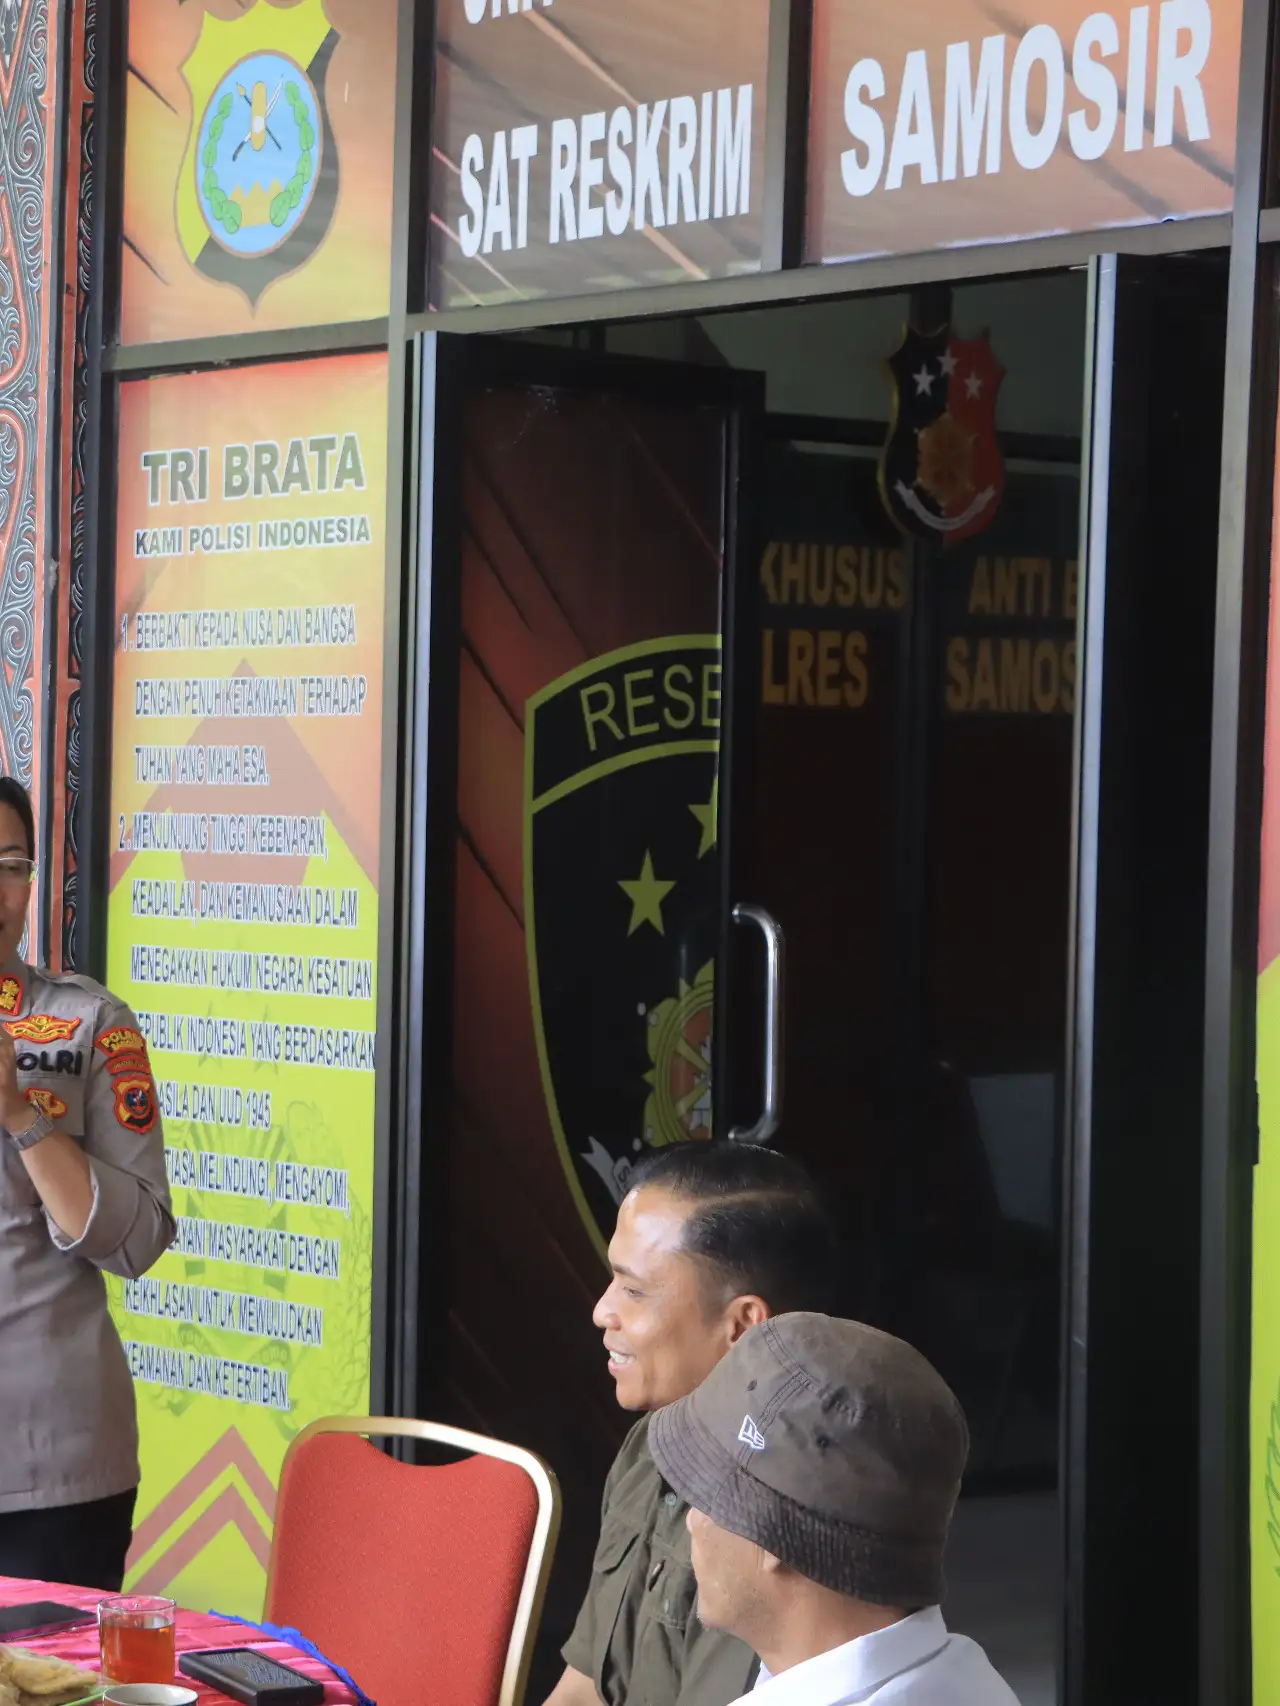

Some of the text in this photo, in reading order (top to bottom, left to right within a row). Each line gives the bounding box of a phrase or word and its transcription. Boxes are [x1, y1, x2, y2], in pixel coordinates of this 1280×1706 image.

[840, 0, 1212, 197] SAMOSIR
[458, 83, 754, 258] SAT RESKRIM
[142, 433, 367, 506] TRI BRATA
[134, 515, 372, 557] KAMI POLISI INDONESIA
[760, 542, 906, 610] KHUSUS
[968, 556, 1052, 617] ANTI
[136, 611, 191, 651] BERBAKTI
[194, 609, 240, 649] KEPADA
[242, 608, 273, 648] NUSA
[277, 606, 301, 646] DAN
[305, 604, 357, 646] BANGSA
[762, 628, 868, 708] LRES
[945, 636, 1077, 714] SAMOS
[135, 675, 367, 718] DENGAN PENUH KETAKWAAN TERHADAP
[580, 664, 721, 752] RESE
[135, 745, 172, 784] TUHAN
[176, 745, 205, 785] YANG
[207, 745, 241, 785] MAHA
[133, 812, 208, 852] MENJUNJUNG
[211, 814, 250, 854] TINGGI
[199, 880, 225, 918] DAN
[227, 882, 311, 924] KEMANUSIAAN
[315, 887, 358, 928] DALAM
[131, 944, 373, 999] MENEGAKKAN HUKUM NEGARA KESATUAN
[17, 1050, 83, 1076] OLRI
[136, 1012, 376, 1071] EPUBLIK INDONESIA YANG BERDASARKAN
[157, 1080, 271, 1131] ASILA DAN UUD 1945
[164, 1147, 197, 1188] TIASA
[167, 1216, 340, 1280] AYANI MASYARAKAT DENGAN
[124, 1277, 194, 1323] KEIKHLASAN
[197, 1287, 236, 1330] UNTUK
[188, 1351, 212, 1393] DAN
